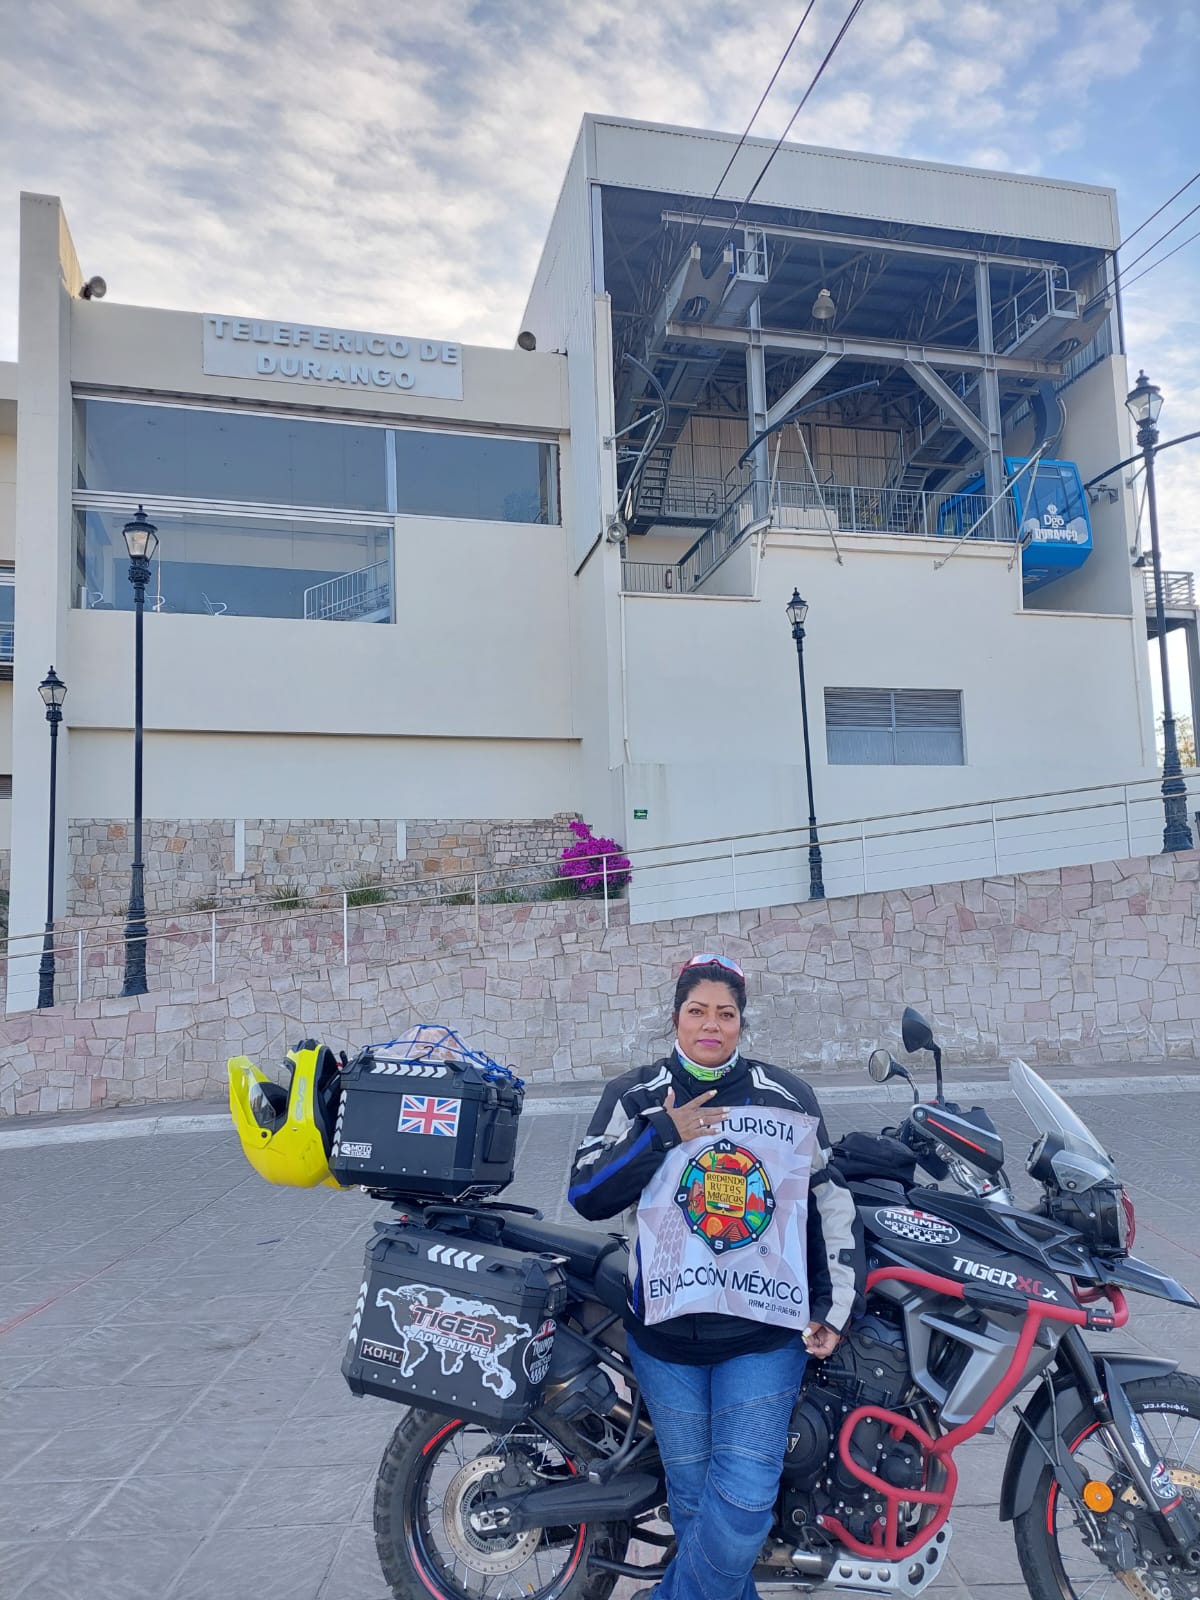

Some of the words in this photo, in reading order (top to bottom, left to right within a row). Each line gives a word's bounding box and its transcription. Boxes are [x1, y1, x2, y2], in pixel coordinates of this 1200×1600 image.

[209, 316, 409, 358] TELEFERICO
[419, 342, 458, 364] DE
[256, 352, 416, 389] DURANGO
[351, 1144, 372, 1152] MOTO
[884, 1210, 953, 1234] TRIUMPH
[884, 1220, 950, 1241] MOTORCYCLES
[714, 1240, 724, 1249] S
[649, 1276, 671, 1298] EN
[675, 1262, 728, 1292] ACCIÓN
[731, 1270, 803, 1304] MÉXICO
[413, 1306, 495, 1345] TIGER
[414, 1331, 489, 1358] ADVENTURE
